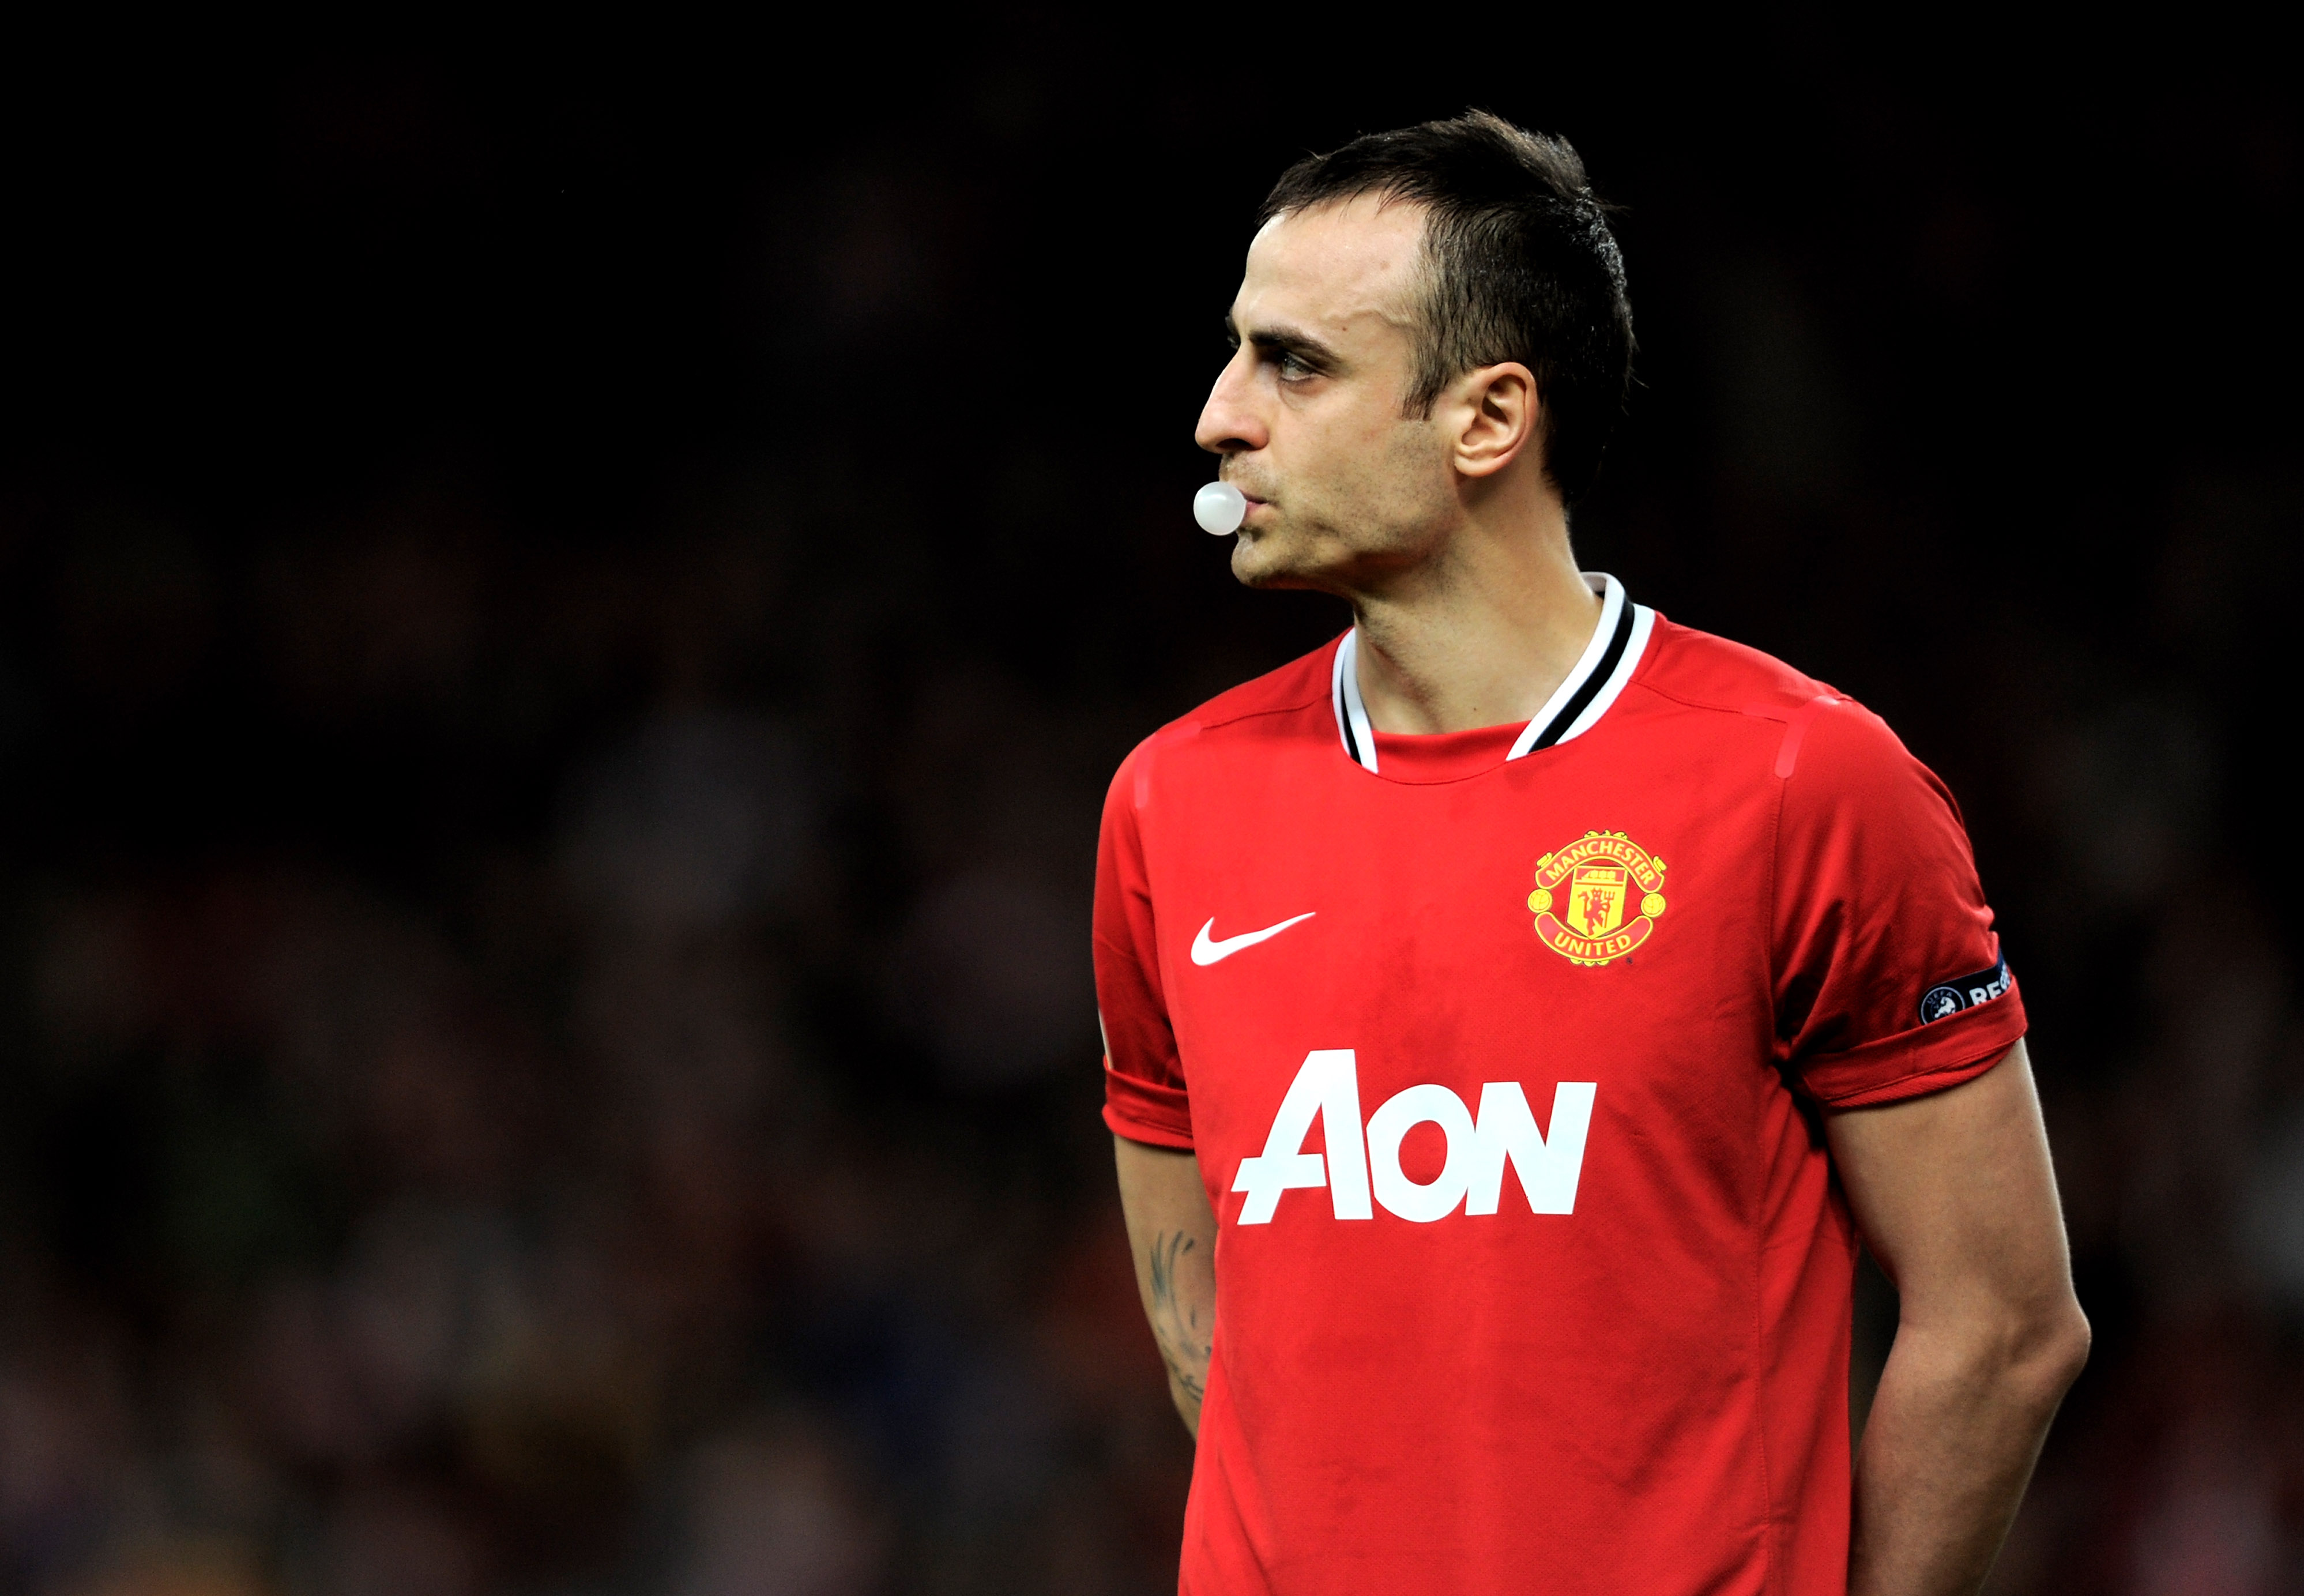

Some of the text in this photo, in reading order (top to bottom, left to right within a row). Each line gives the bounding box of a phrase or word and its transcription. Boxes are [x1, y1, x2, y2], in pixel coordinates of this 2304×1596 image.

[1545, 841, 1655, 885] MANCHESTER
[1554, 932, 1631, 956] UNITED
[1231, 1048, 1597, 1225] AON
